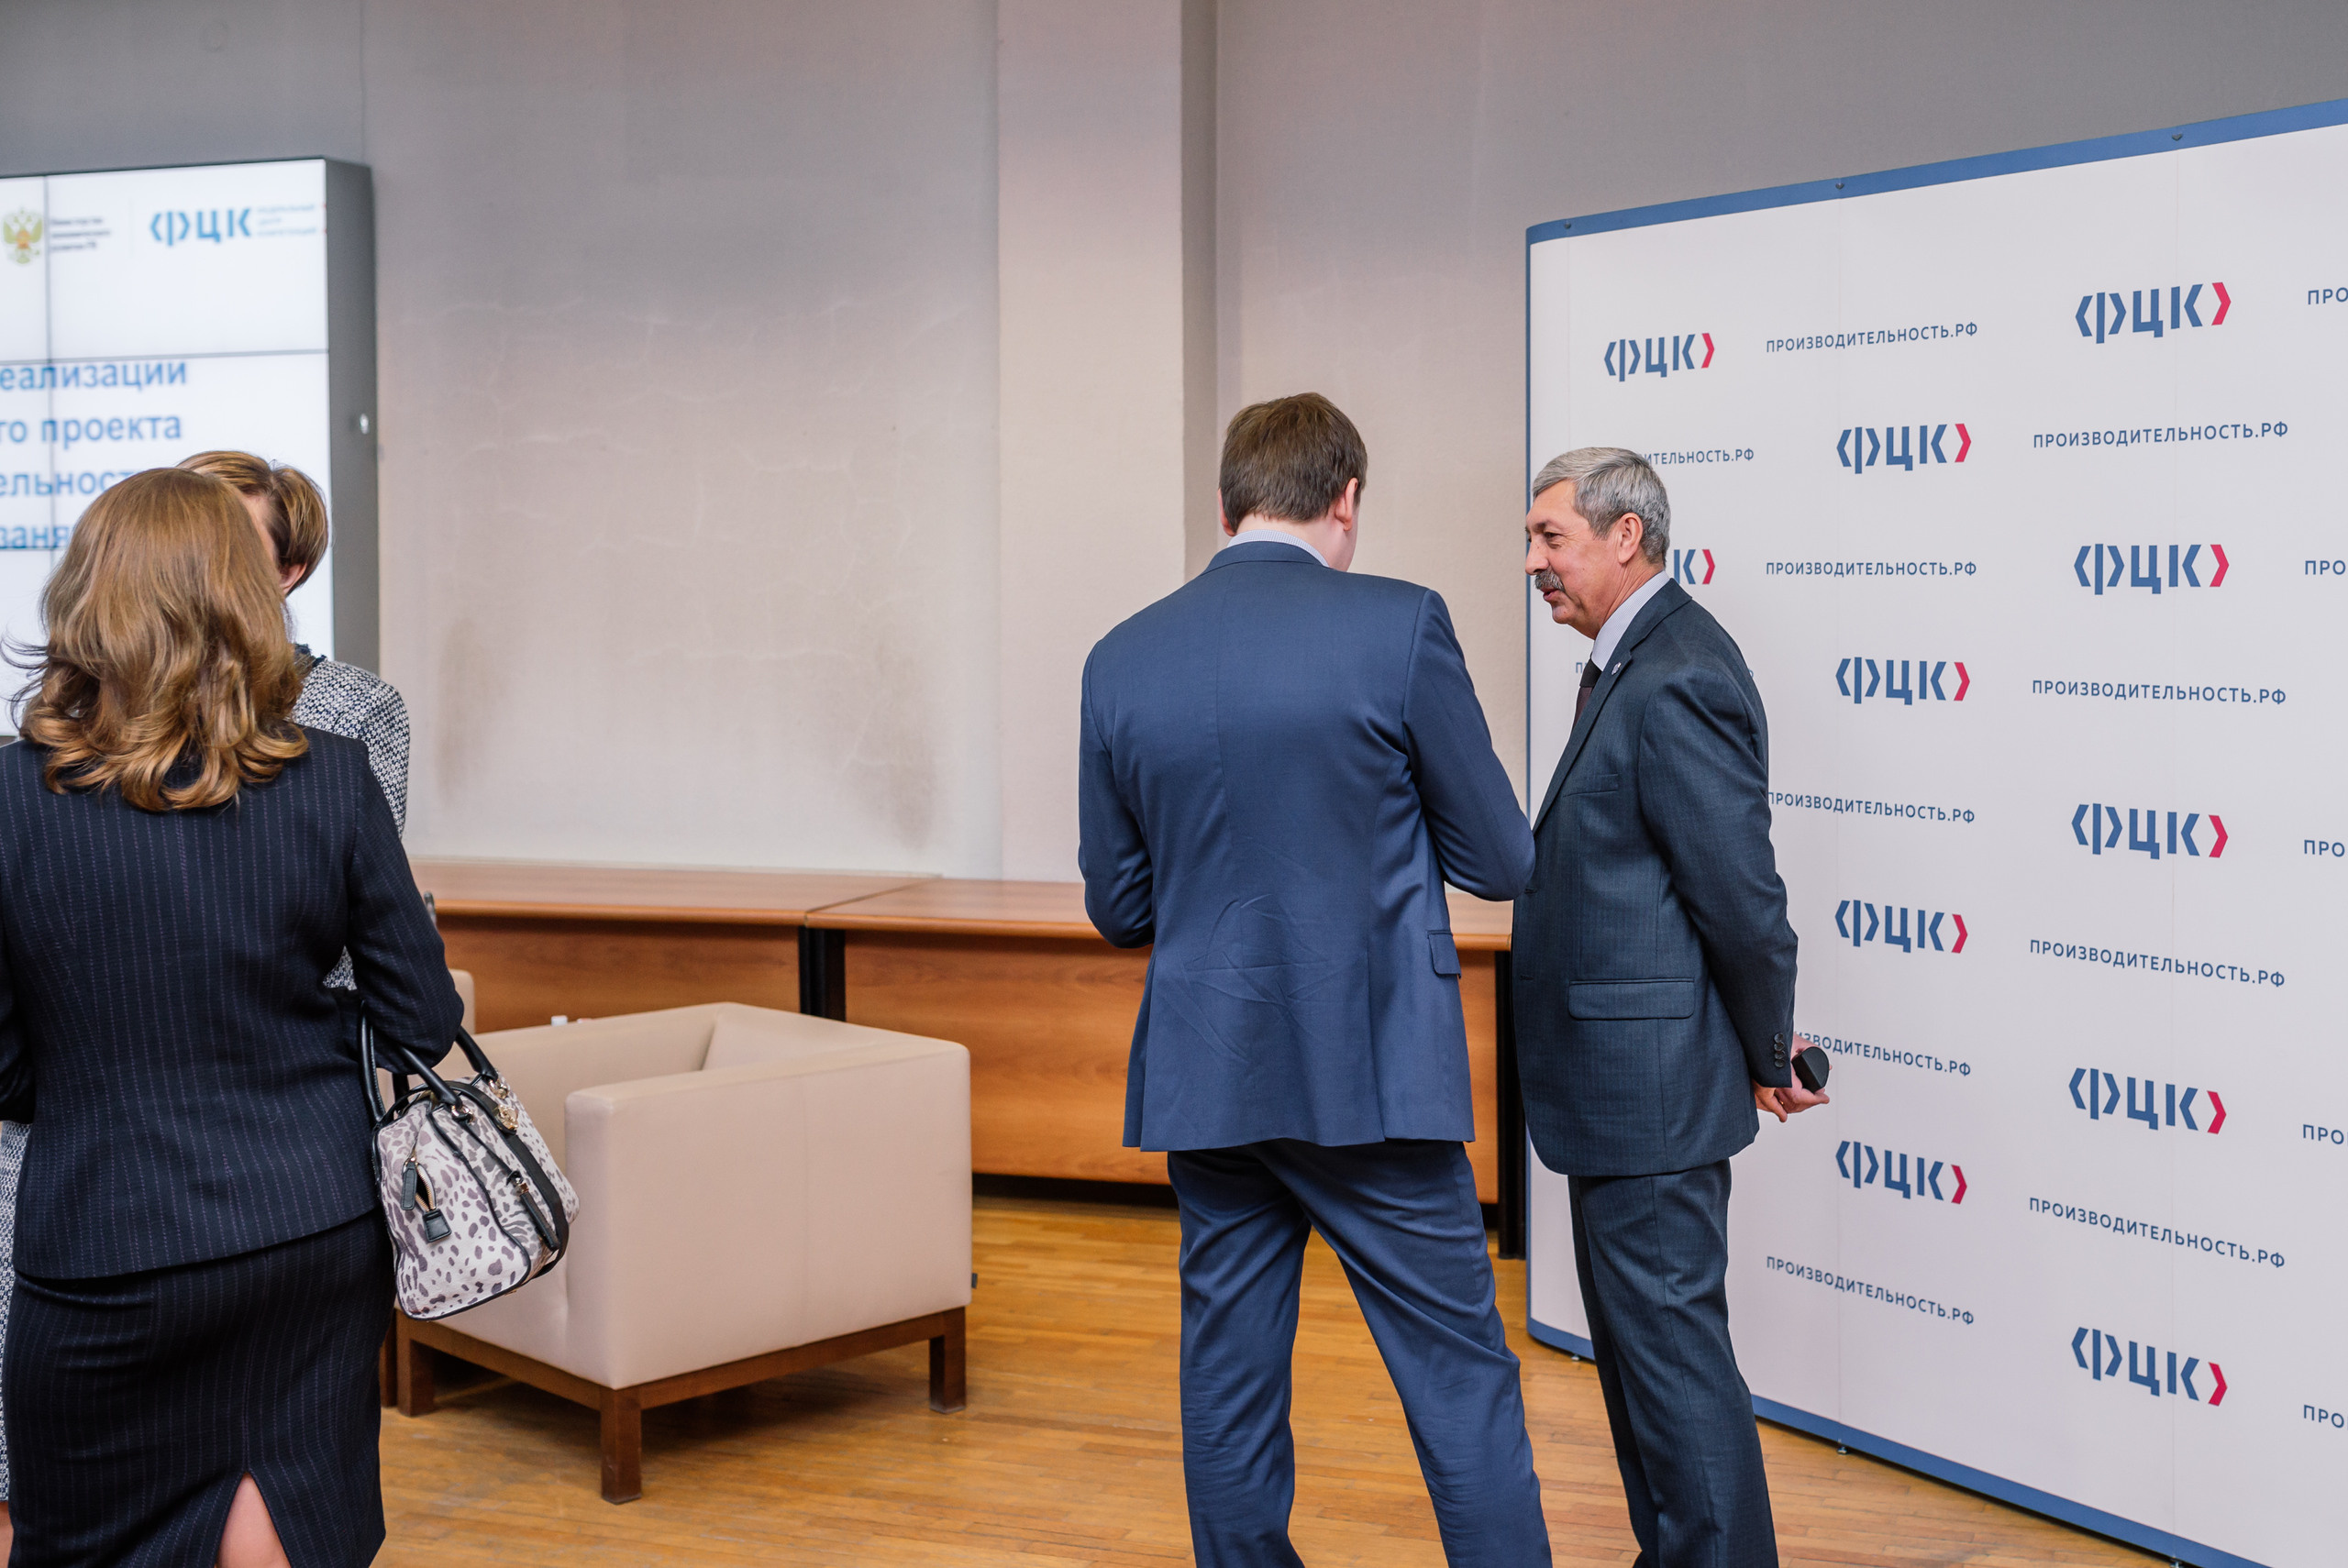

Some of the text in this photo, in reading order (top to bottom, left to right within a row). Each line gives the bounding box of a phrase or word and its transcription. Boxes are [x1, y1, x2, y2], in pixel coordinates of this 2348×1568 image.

[150, 208, 251, 247] ФЦК
[1767, 322, 1977, 353] ПРОИЗВОДИТЕЛЬНОСТЬ.РФ
[2075, 283, 2204, 345] ФЦК
[1604, 334, 1696, 382] ФЦК
[41, 415, 182, 450] проекта
[1643, 447, 1755, 465] ИТЕЛЬНОСТЬ.РФ
[1836, 424, 1948, 475] ФЦК
[2033, 421, 2288, 448] ПРОИЗВОДИТЕЛЬНОСТЬ.РФ
[1766, 561, 1977, 578] ПРОИЗВОДИТЕЛЬНОСТЬ.РФ
[2073, 543, 2202, 596] ФЦК
[1835, 656, 1947, 706] ФЦК
[2032, 679, 2287, 705] ПРОИЗВОДИТЕЛЬНОСТЬ.РФ
[2071, 802, 2200, 861] ФЦК
[1833, 899, 1945, 954] ФЦК
[2030, 938, 2285, 988] ПРОИЗВОДИТЕЛЬНОСТЬ.РФ
[1796, 1032, 1972, 1077] ЗВОДИТЕЛЬНОСТЬ.РФ
[2068, 1067, 2198, 1131] ФЦК
[1835, 1140, 1944, 1201] ФЦК
[2029, 1197, 2285, 1268] ПРОИЗВОДИТЕЛЬНОСТЬ.РФ
[1767, 1256, 1975, 1326] ПРОИЗВОДИТЕЛЬНОСТЬ.РФ
[2071, 1327, 2200, 1402] ФЦК
